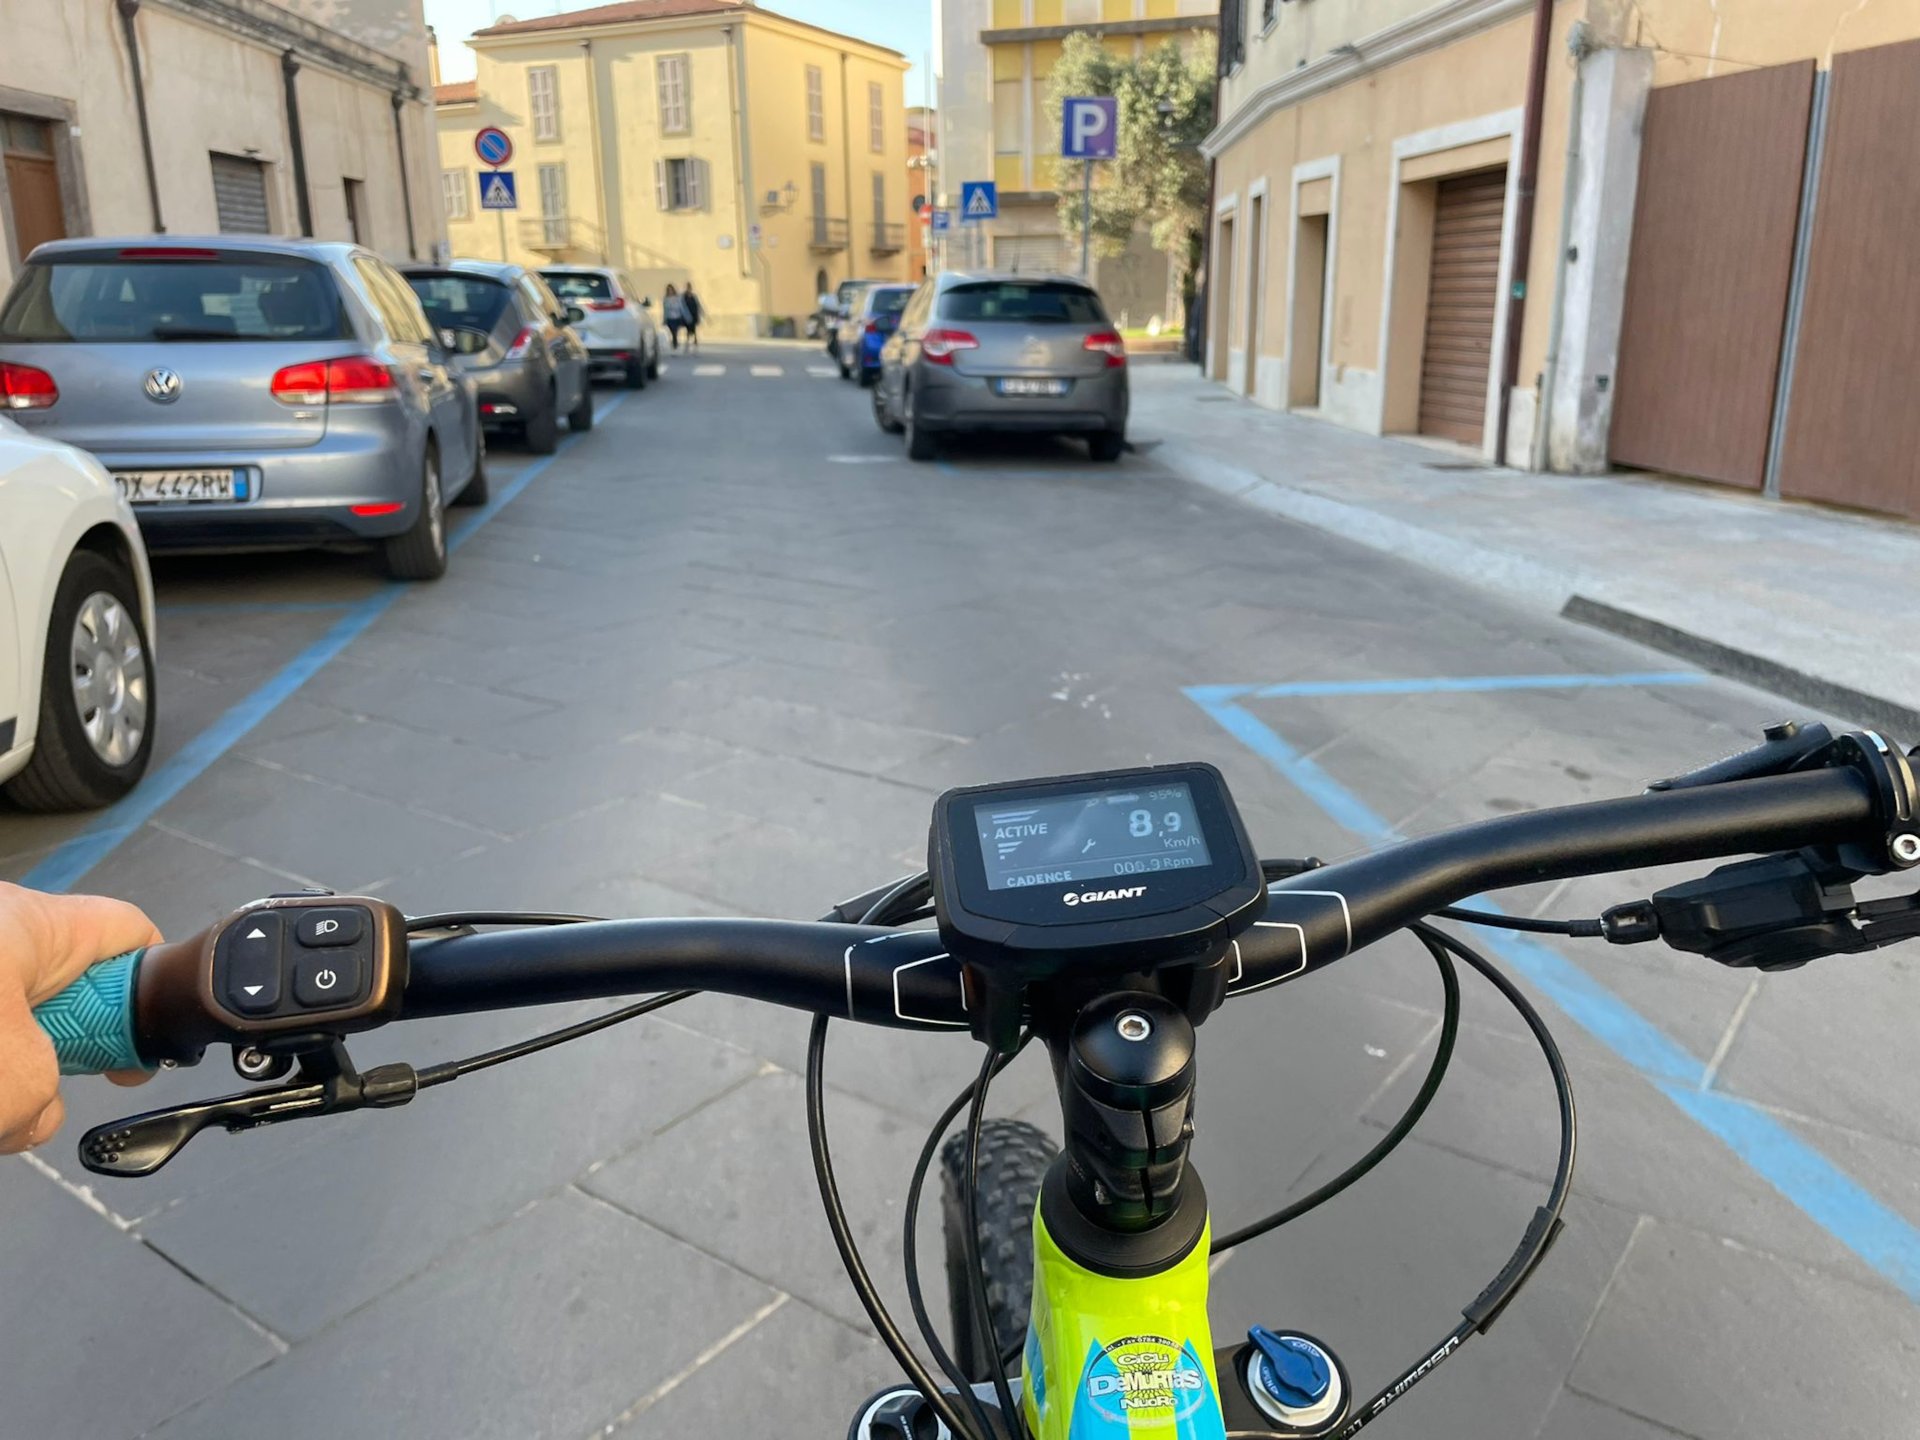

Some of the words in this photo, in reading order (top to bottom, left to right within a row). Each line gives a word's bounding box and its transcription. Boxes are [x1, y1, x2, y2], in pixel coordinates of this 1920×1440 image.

[1071, 103, 1108, 153] P
[994, 822, 1049, 840] ACTIVE
[1163, 835, 1201, 848] Km/h
[1006, 870, 1073, 888] CADENCE
[1080, 885, 1148, 904] GIANT
